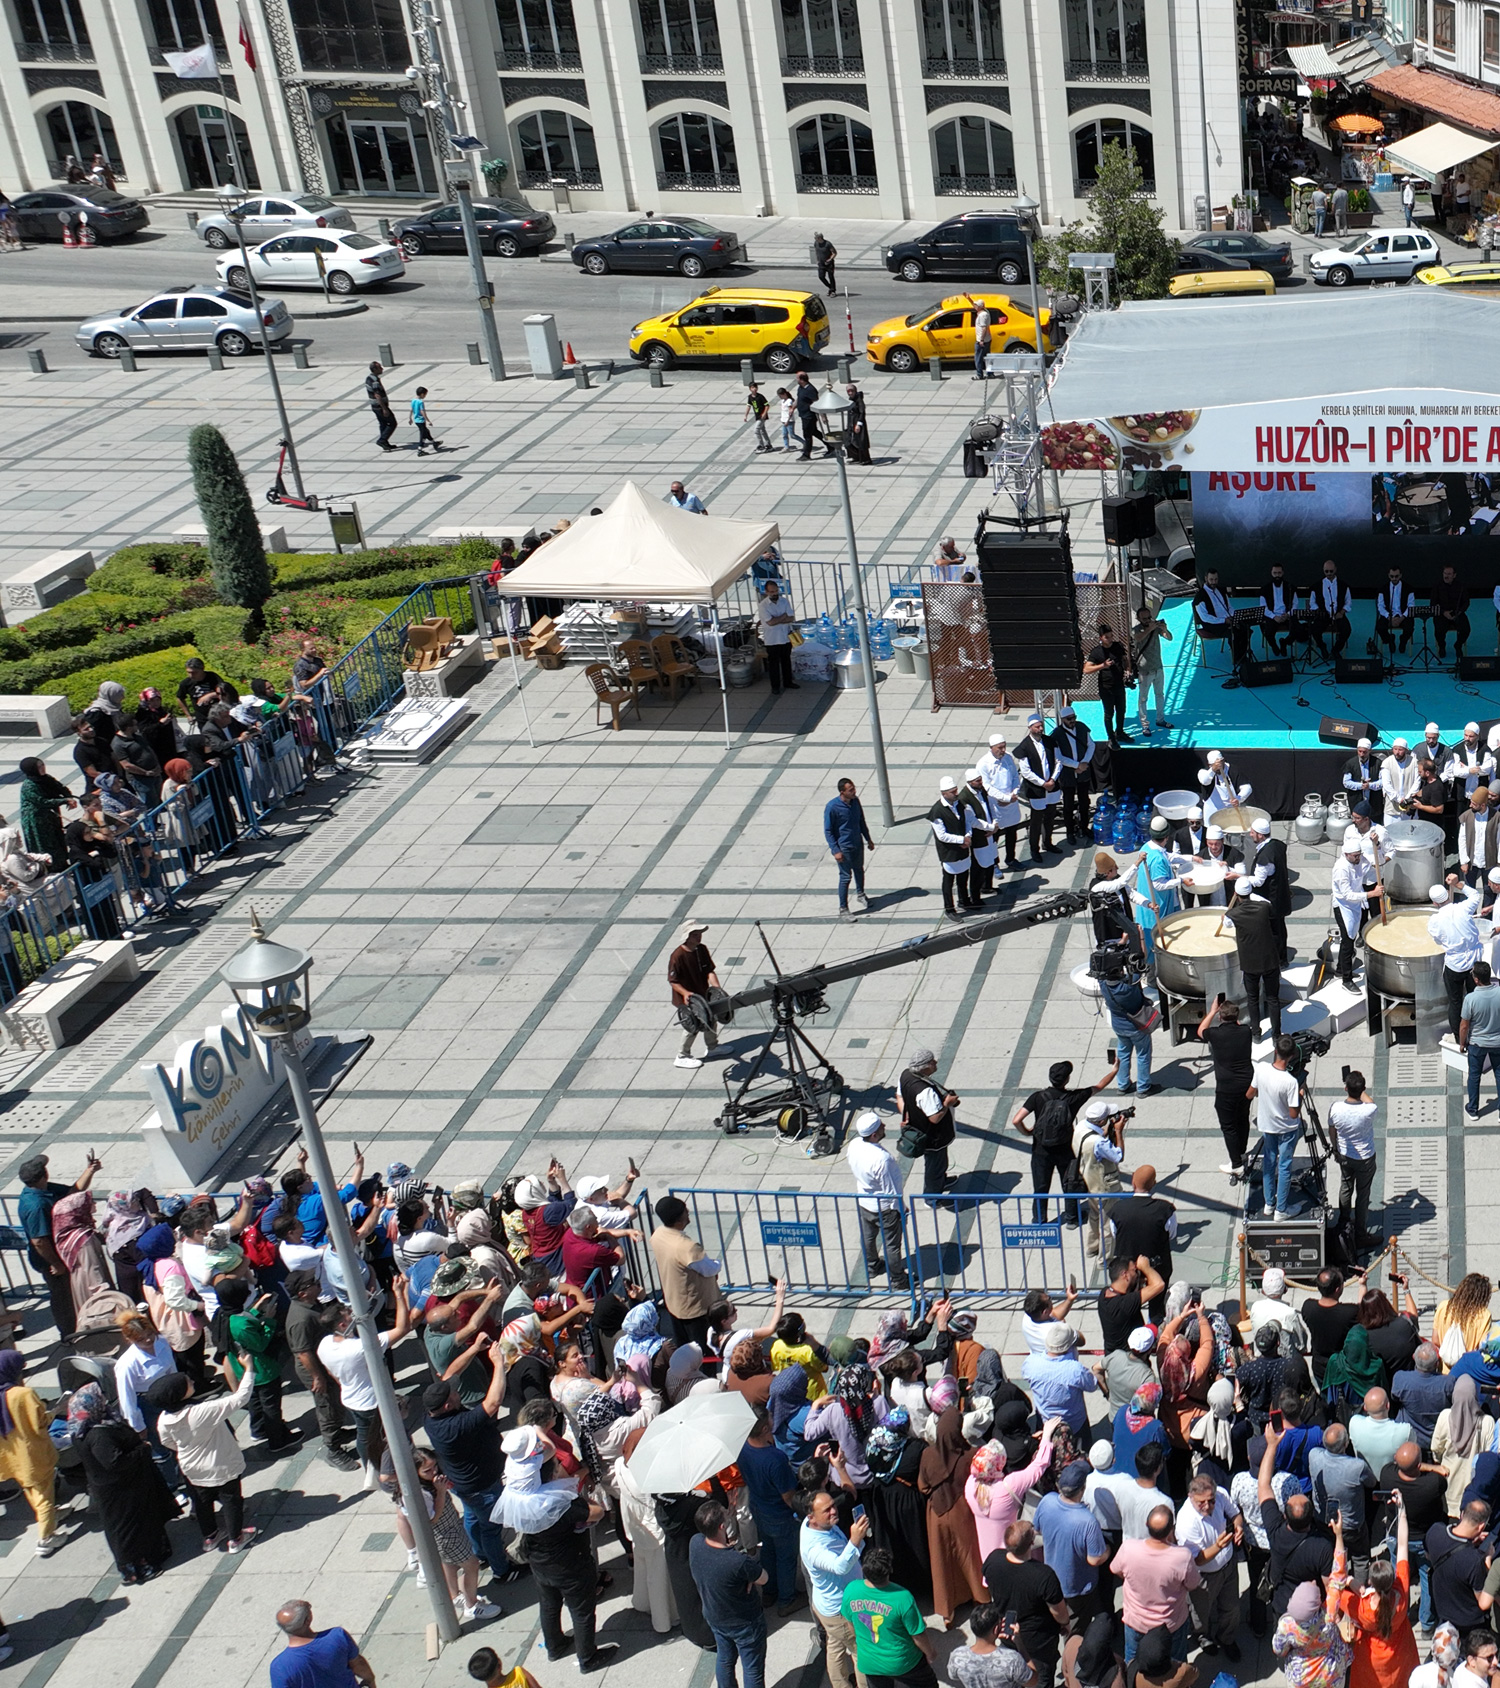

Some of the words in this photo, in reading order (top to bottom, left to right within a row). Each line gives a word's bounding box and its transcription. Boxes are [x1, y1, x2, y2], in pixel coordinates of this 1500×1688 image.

[1272, 15, 1307, 23] OTOPARK
[1238, 23, 1249, 75] KONYA
[1239, 79, 1295, 93] SOFRASI
[1321, 405, 1351, 416] KERBELA
[1352, 404, 1386, 417] ŞEHİTLERİ
[1387, 405, 1418, 417] RUHUNA,
[1419, 405, 1459, 416] MUHARREM
[1461, 405, 1472, 416] AYI
[187, 1077, 245, 1143] Gönüllerin
[211, 1110, 242, 1150] Şehri
[766, 1226, 815, 1237] BÜYÜKŞEHİR
[1006, 1228, 1056, 1238] BÜYÜKŞEHİR
[850, 1599, 892, 1617] BRYANT
